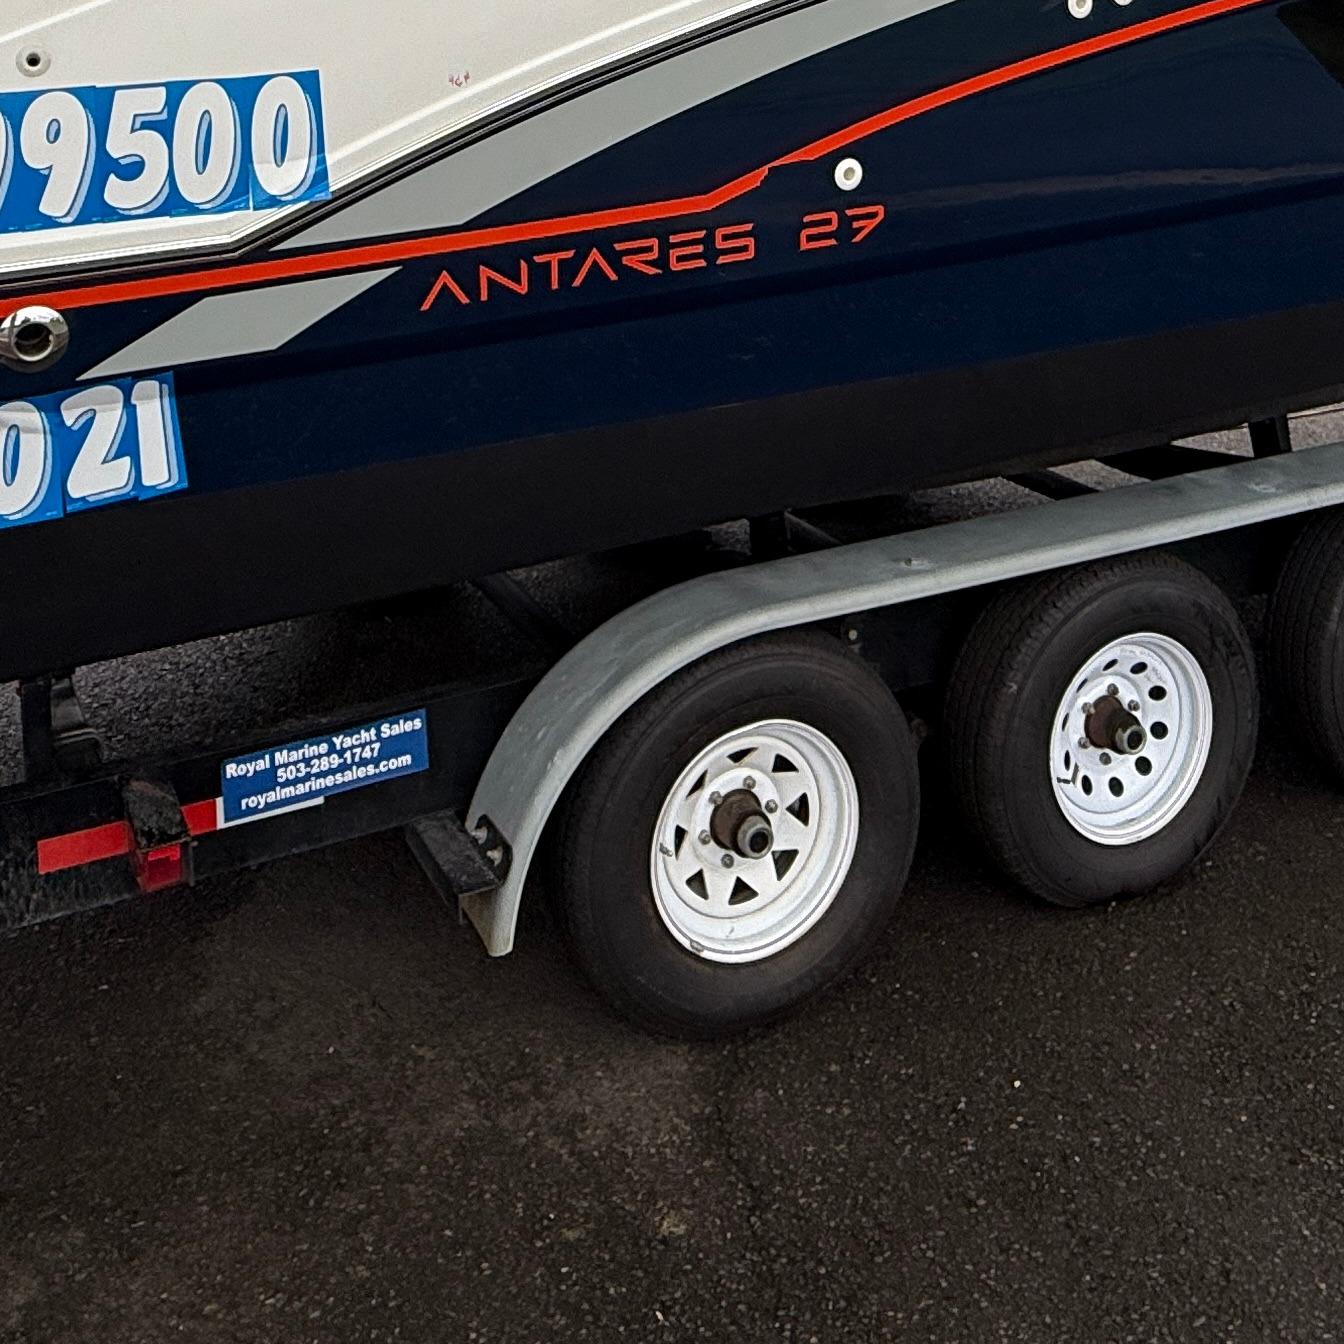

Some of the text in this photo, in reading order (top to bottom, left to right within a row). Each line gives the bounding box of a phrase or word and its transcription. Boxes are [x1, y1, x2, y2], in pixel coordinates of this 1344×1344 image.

[419, 204, 885, 312] ANTARES 27
[225, 716, 423, 780] Royal Marine Yacht Sales
[276, 742, 381, 783] 503-289-1747
[240, 753, 412, 810] royalmarinesales.com
